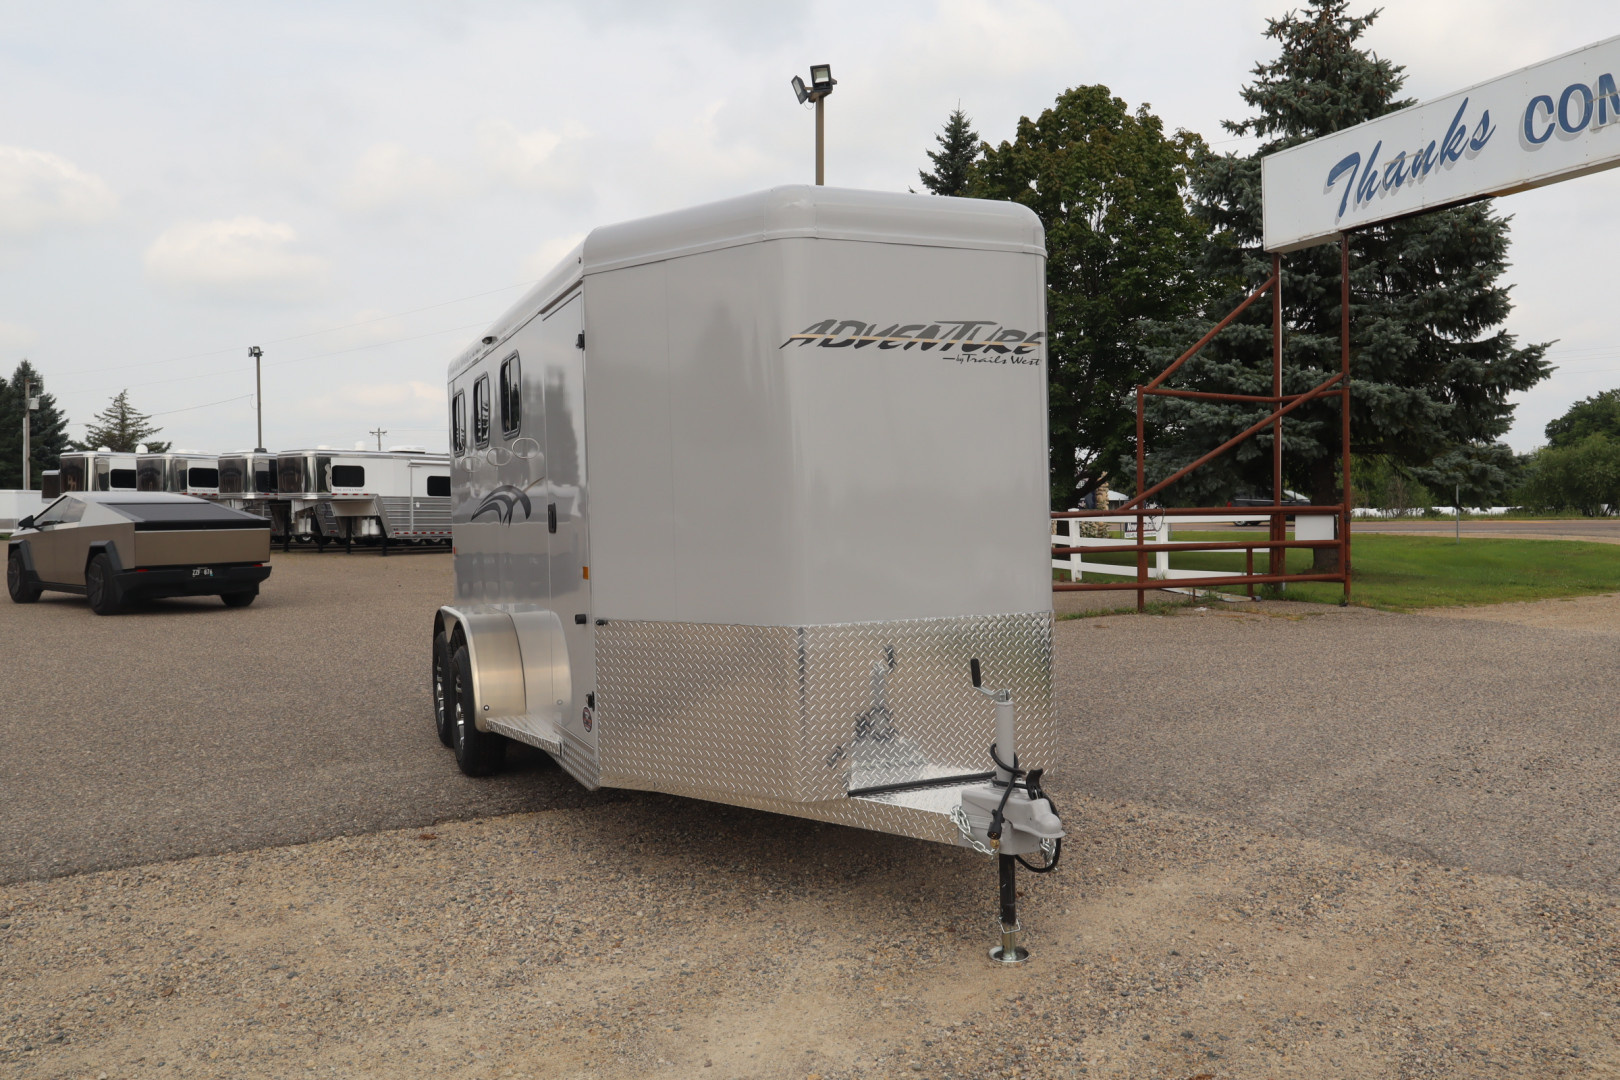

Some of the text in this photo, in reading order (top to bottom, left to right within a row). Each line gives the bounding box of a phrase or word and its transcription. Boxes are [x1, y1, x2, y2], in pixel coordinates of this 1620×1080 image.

[1327, 97, 1496, 218] Thanks
[779, 319, 1045, 354] ADVENTURE
[962, 353, 1007, 365] Trails
[1011, 355, 1040, 366] West
